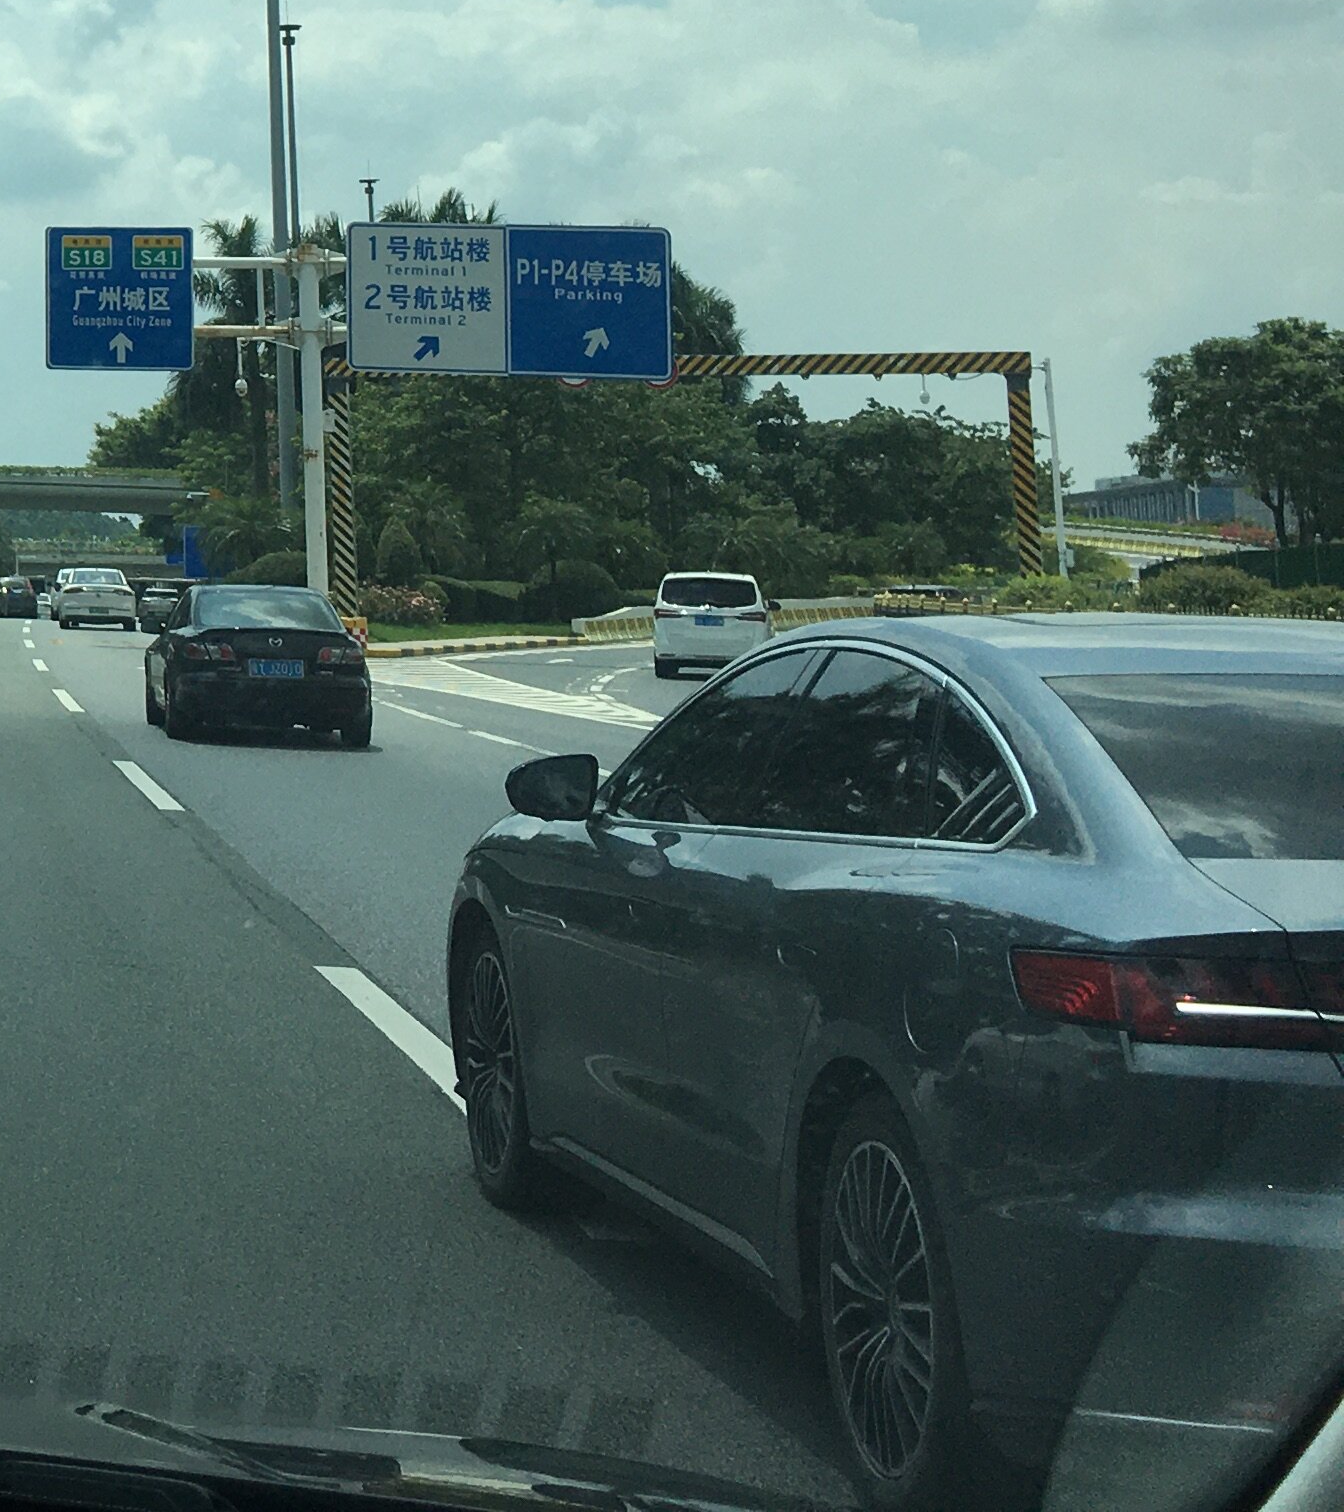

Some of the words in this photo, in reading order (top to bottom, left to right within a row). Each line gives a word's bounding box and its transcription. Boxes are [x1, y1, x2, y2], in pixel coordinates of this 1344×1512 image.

[368, 235, 490, 263] 1号航站楼
[69, 250, 105, 265] S18
[140, 250, 177, 265] S41
[385, 264, 455, 277] Terminal
[461, 266, 467, 277] 1
[516, 258, 662, 288] P1-P4停车场
[72, 285, 171, 311] 广州城区
[364, 283, 492, 312] 2号航站楼
[554, 288, 623, 304] Parking
[72, 315, 124, 328] Guangzhou
[126, 315, 147, 328] City
[149, 316, 172, 327] Zone
[385, 313, 452, 326] Terminal
[457, 315, 467, 326] 2
